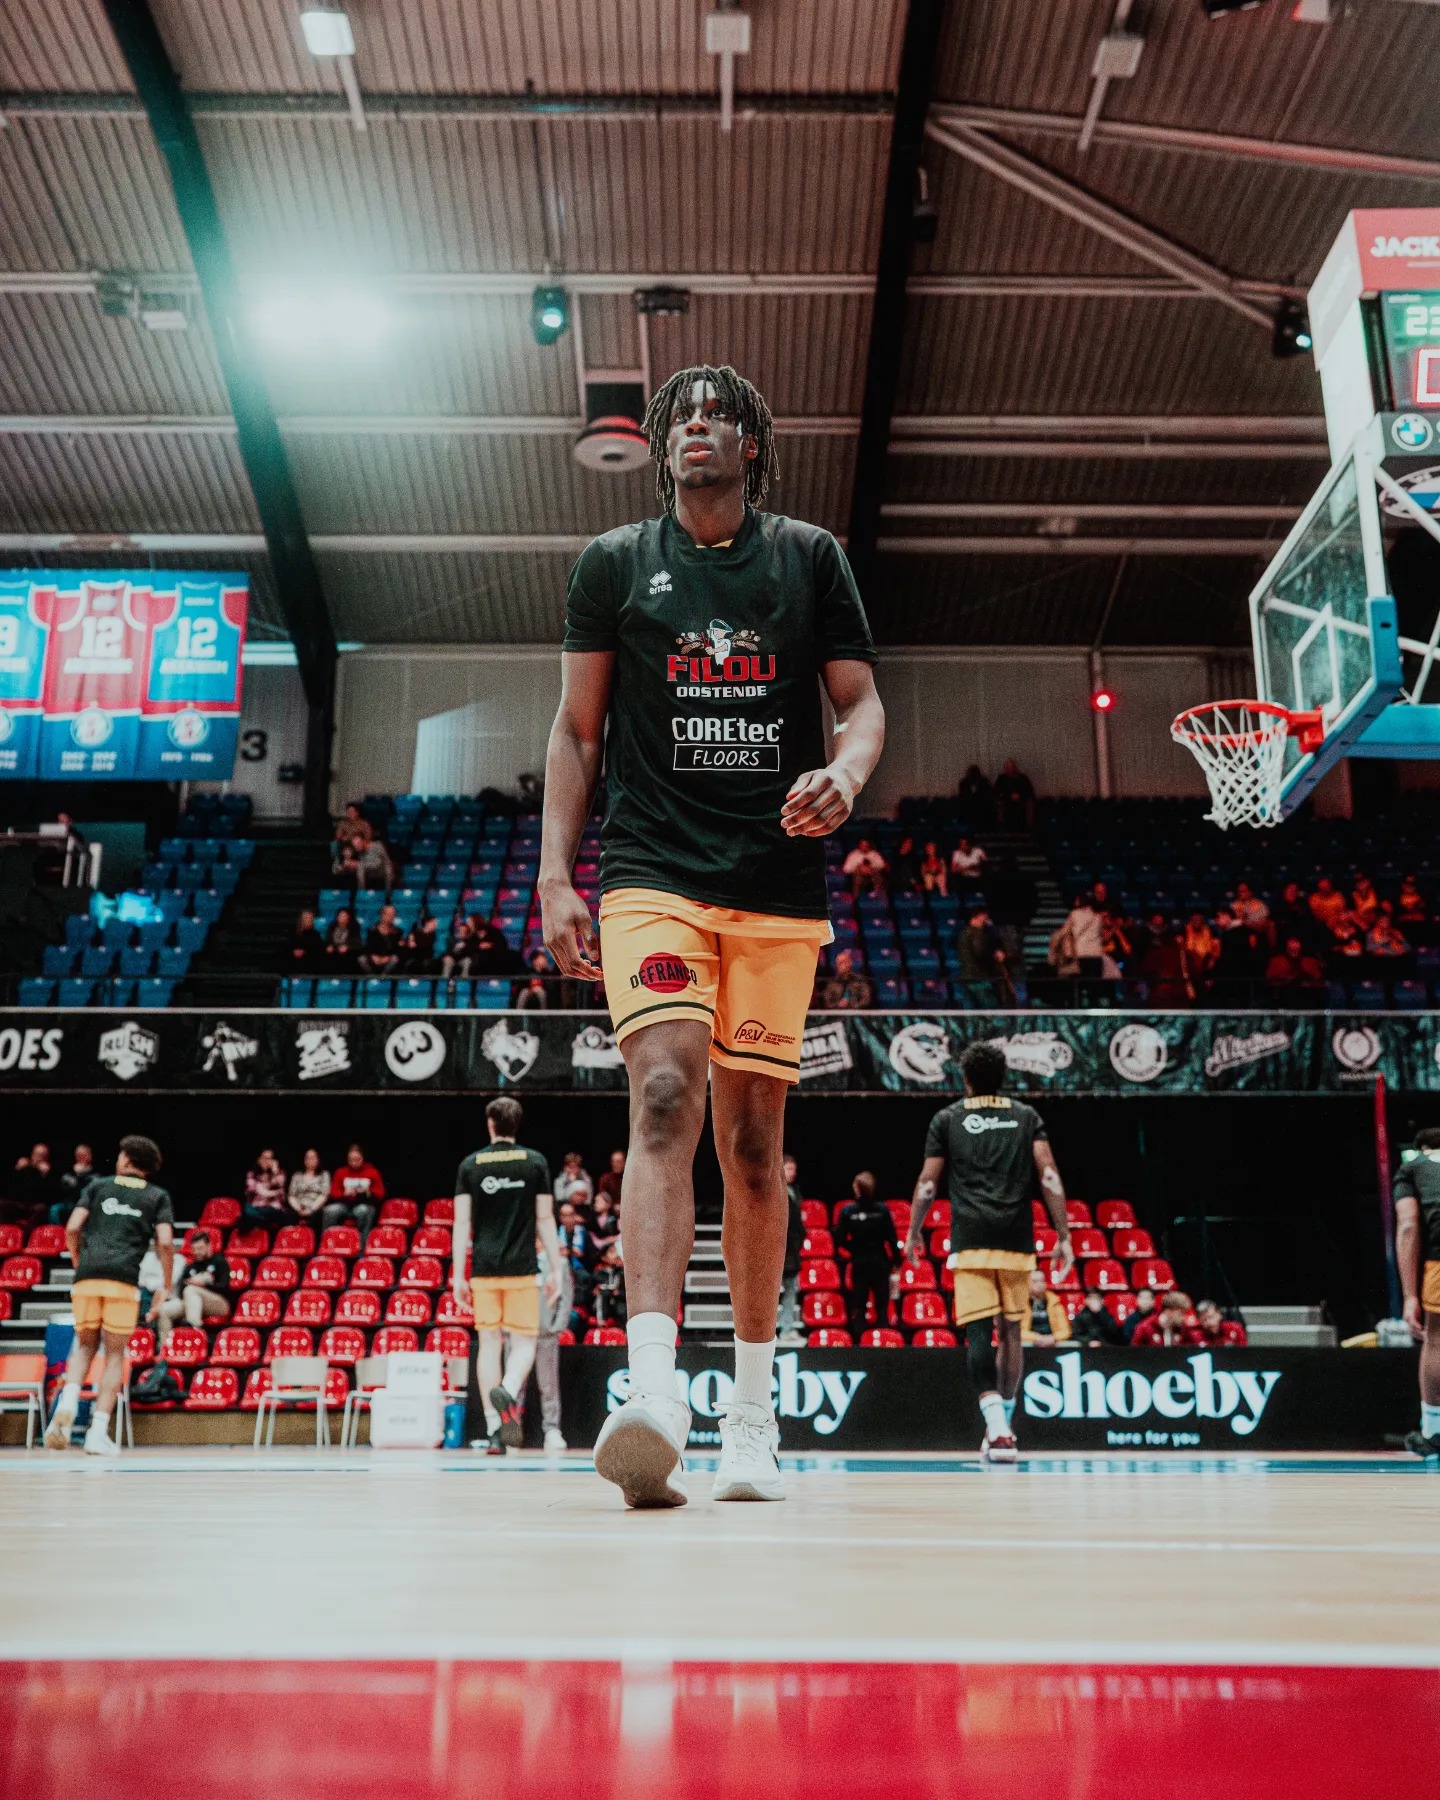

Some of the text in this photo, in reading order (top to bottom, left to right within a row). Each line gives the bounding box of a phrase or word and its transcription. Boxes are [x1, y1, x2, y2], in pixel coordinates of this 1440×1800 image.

[79, 616, 124, 658] 12
[174, 617, 218, 658] 12
[667, 655, 776, 682] FILOU
[676, 686, 767, 698] OOSTENDE
[241, 730, 268, 762] 3
[693, 750, 760, 766] FLOORS
[629, 961, 698, 989] DEFRANCQ
[738, 1028, 765, 1041] P&V
[1023, 1351, 1282, 1435] shoeby
